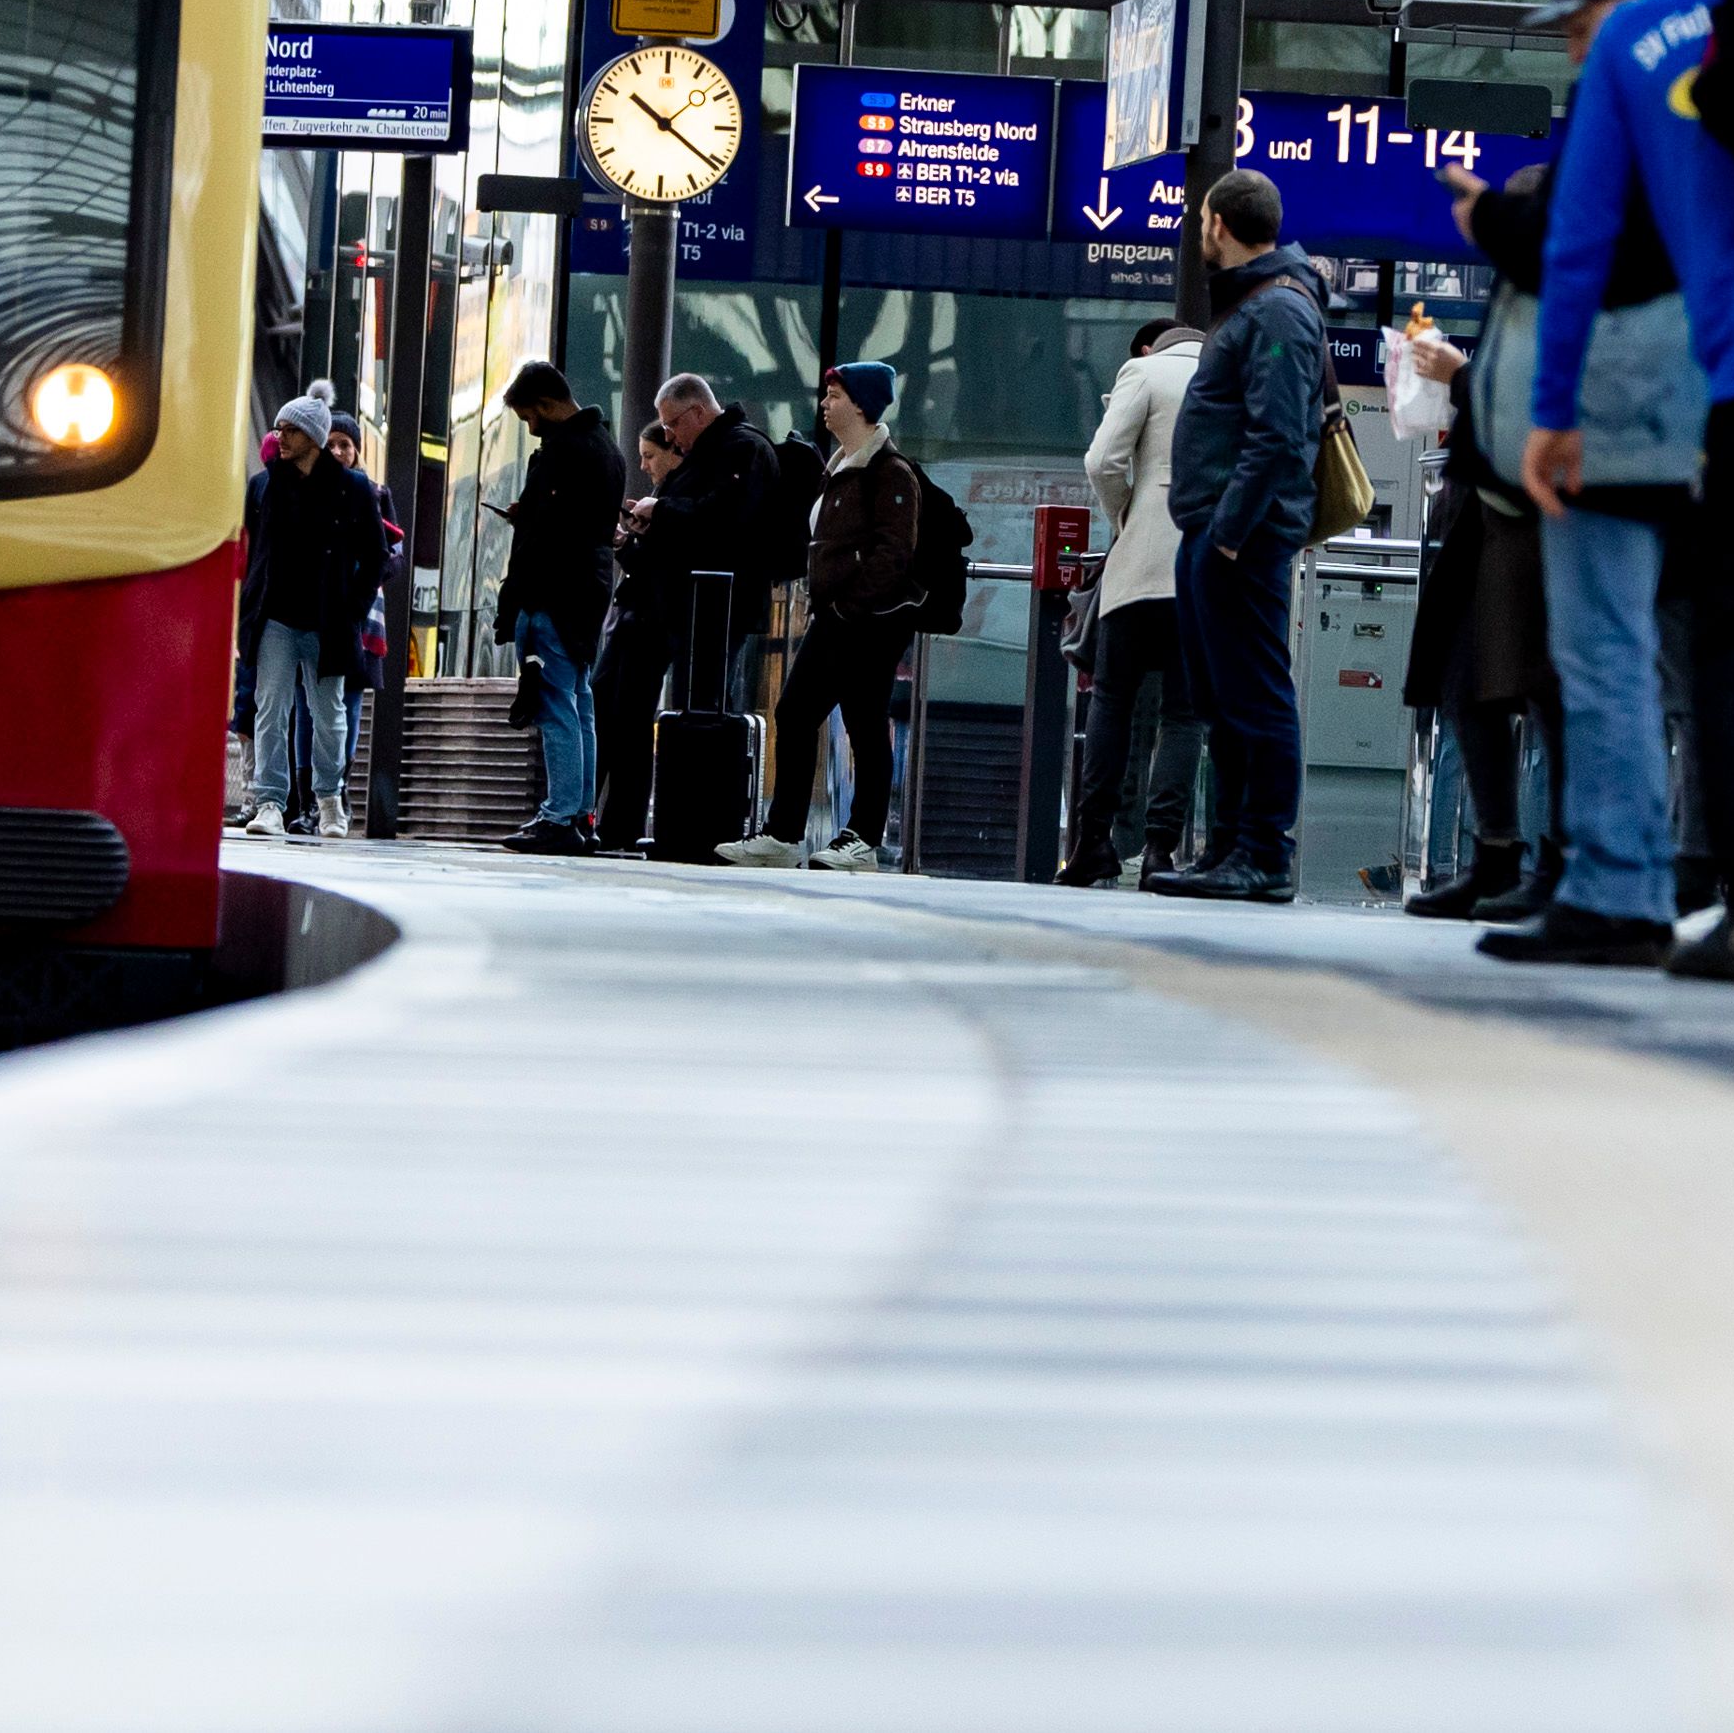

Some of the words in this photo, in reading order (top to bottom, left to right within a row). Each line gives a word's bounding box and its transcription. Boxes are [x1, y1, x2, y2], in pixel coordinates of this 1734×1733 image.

[265, 35, 313, 59] Nord
[412, 105, 428, 119] 20
[430, 108, 447, 120] min
[899, 93, 955, 113] Erkner
[292, 119, 353, 135] Zugverkehr
[355, 123, 373, 135] zw.
[376, 122, 447, 138] Charlottenbu
[899, 116, 991, 141] Strausberg
[995, 121, 1037, 141] Nord
[898, 140, 1000, 162] Ahrensfelde
[1268, 138, 1312, 161] und
[916, 164, 952, 182] BER
[956, 166, 991, 185] T1-2
[995, 168, 1019, 186] via
[915, 186, 951, 205] BER
[955, 188, 976, 207] T5
[682, 221, 716, 240] T1-2
[720, 223, 745, 241] via
[1148, 214, 1172, 228] Exit
[681, 243, 701, 261] T5
